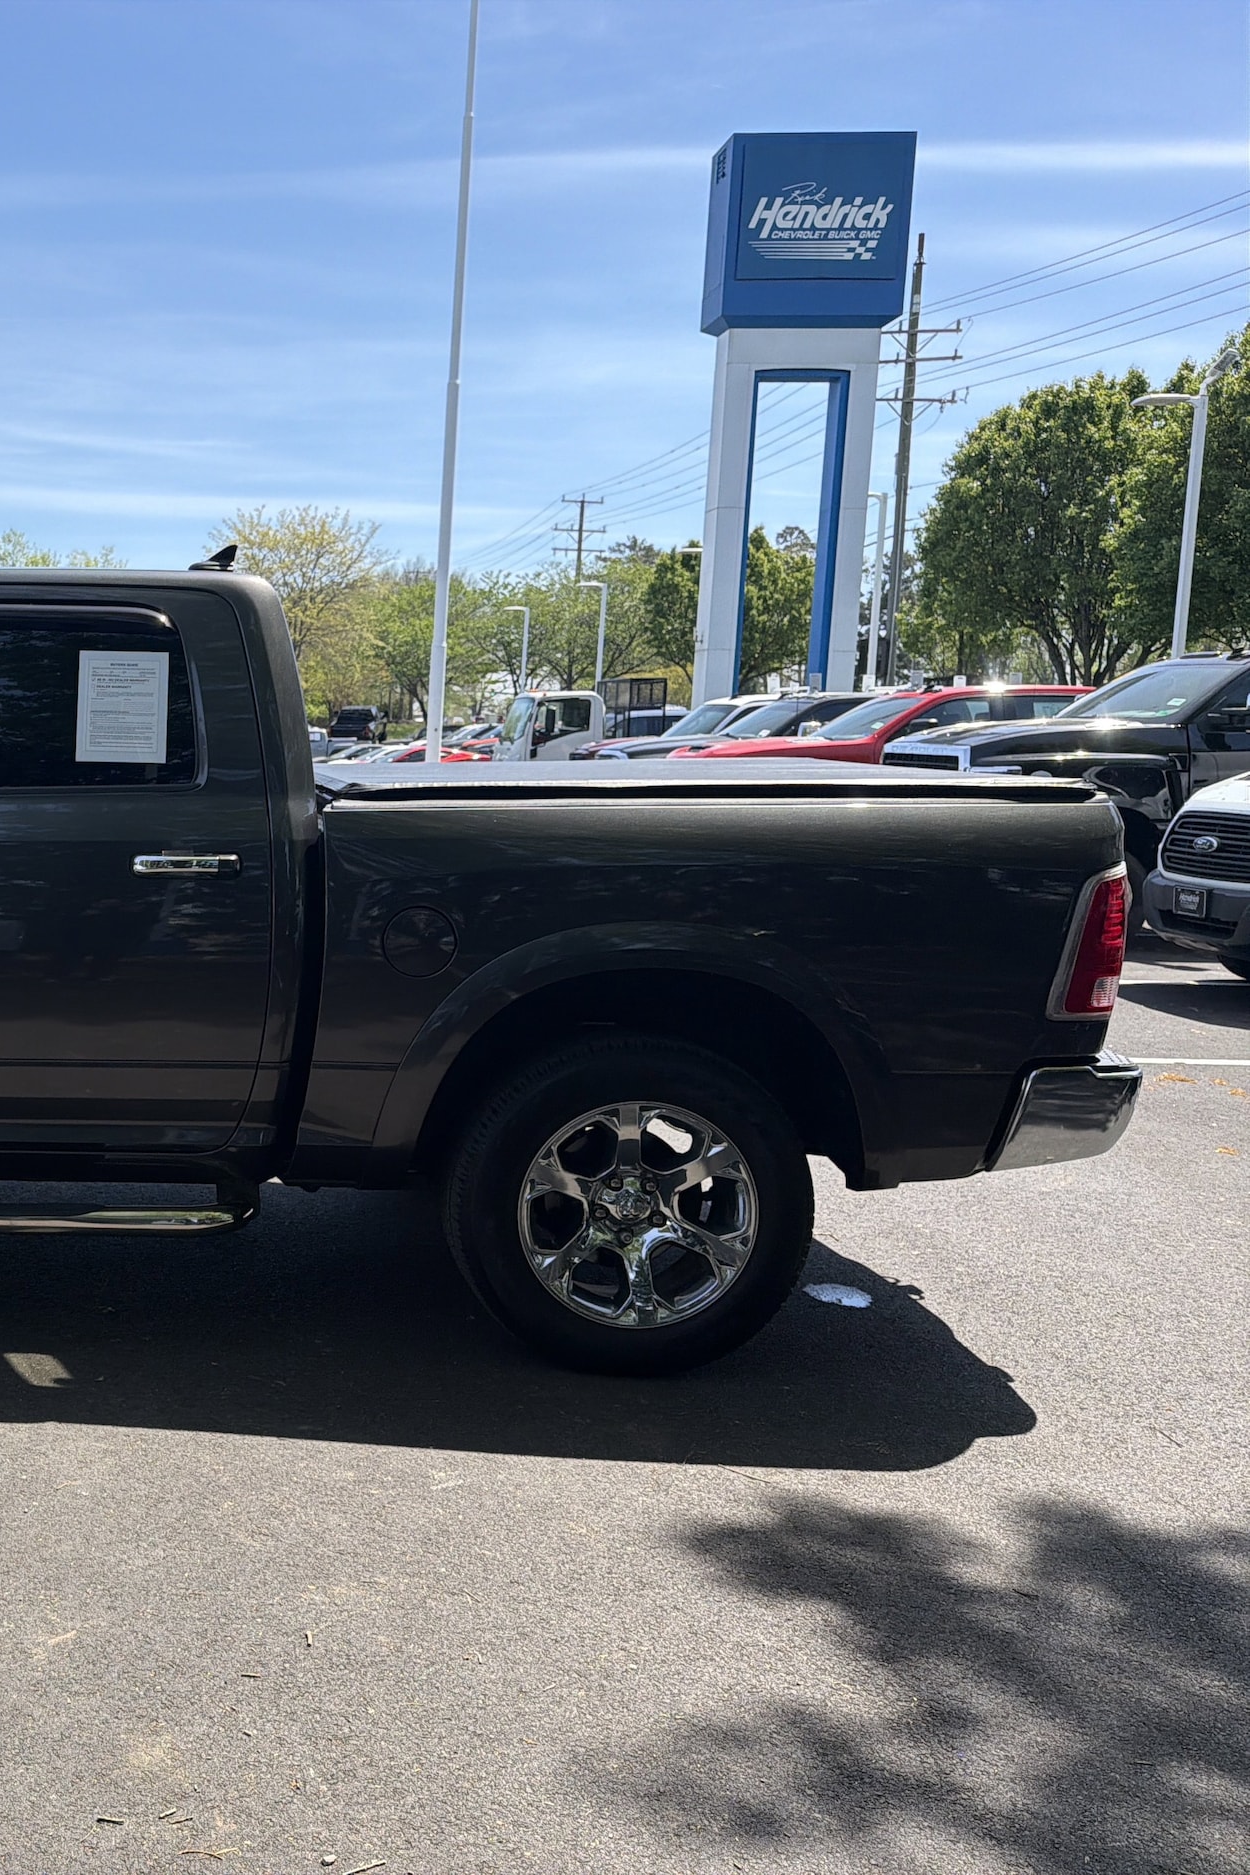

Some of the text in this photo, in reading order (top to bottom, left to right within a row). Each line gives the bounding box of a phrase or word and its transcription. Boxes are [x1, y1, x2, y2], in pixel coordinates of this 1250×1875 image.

[747, 196, 894, 239] Hendrick
[770, 230, 882, 239] CHEVROLET BUICK GMC
